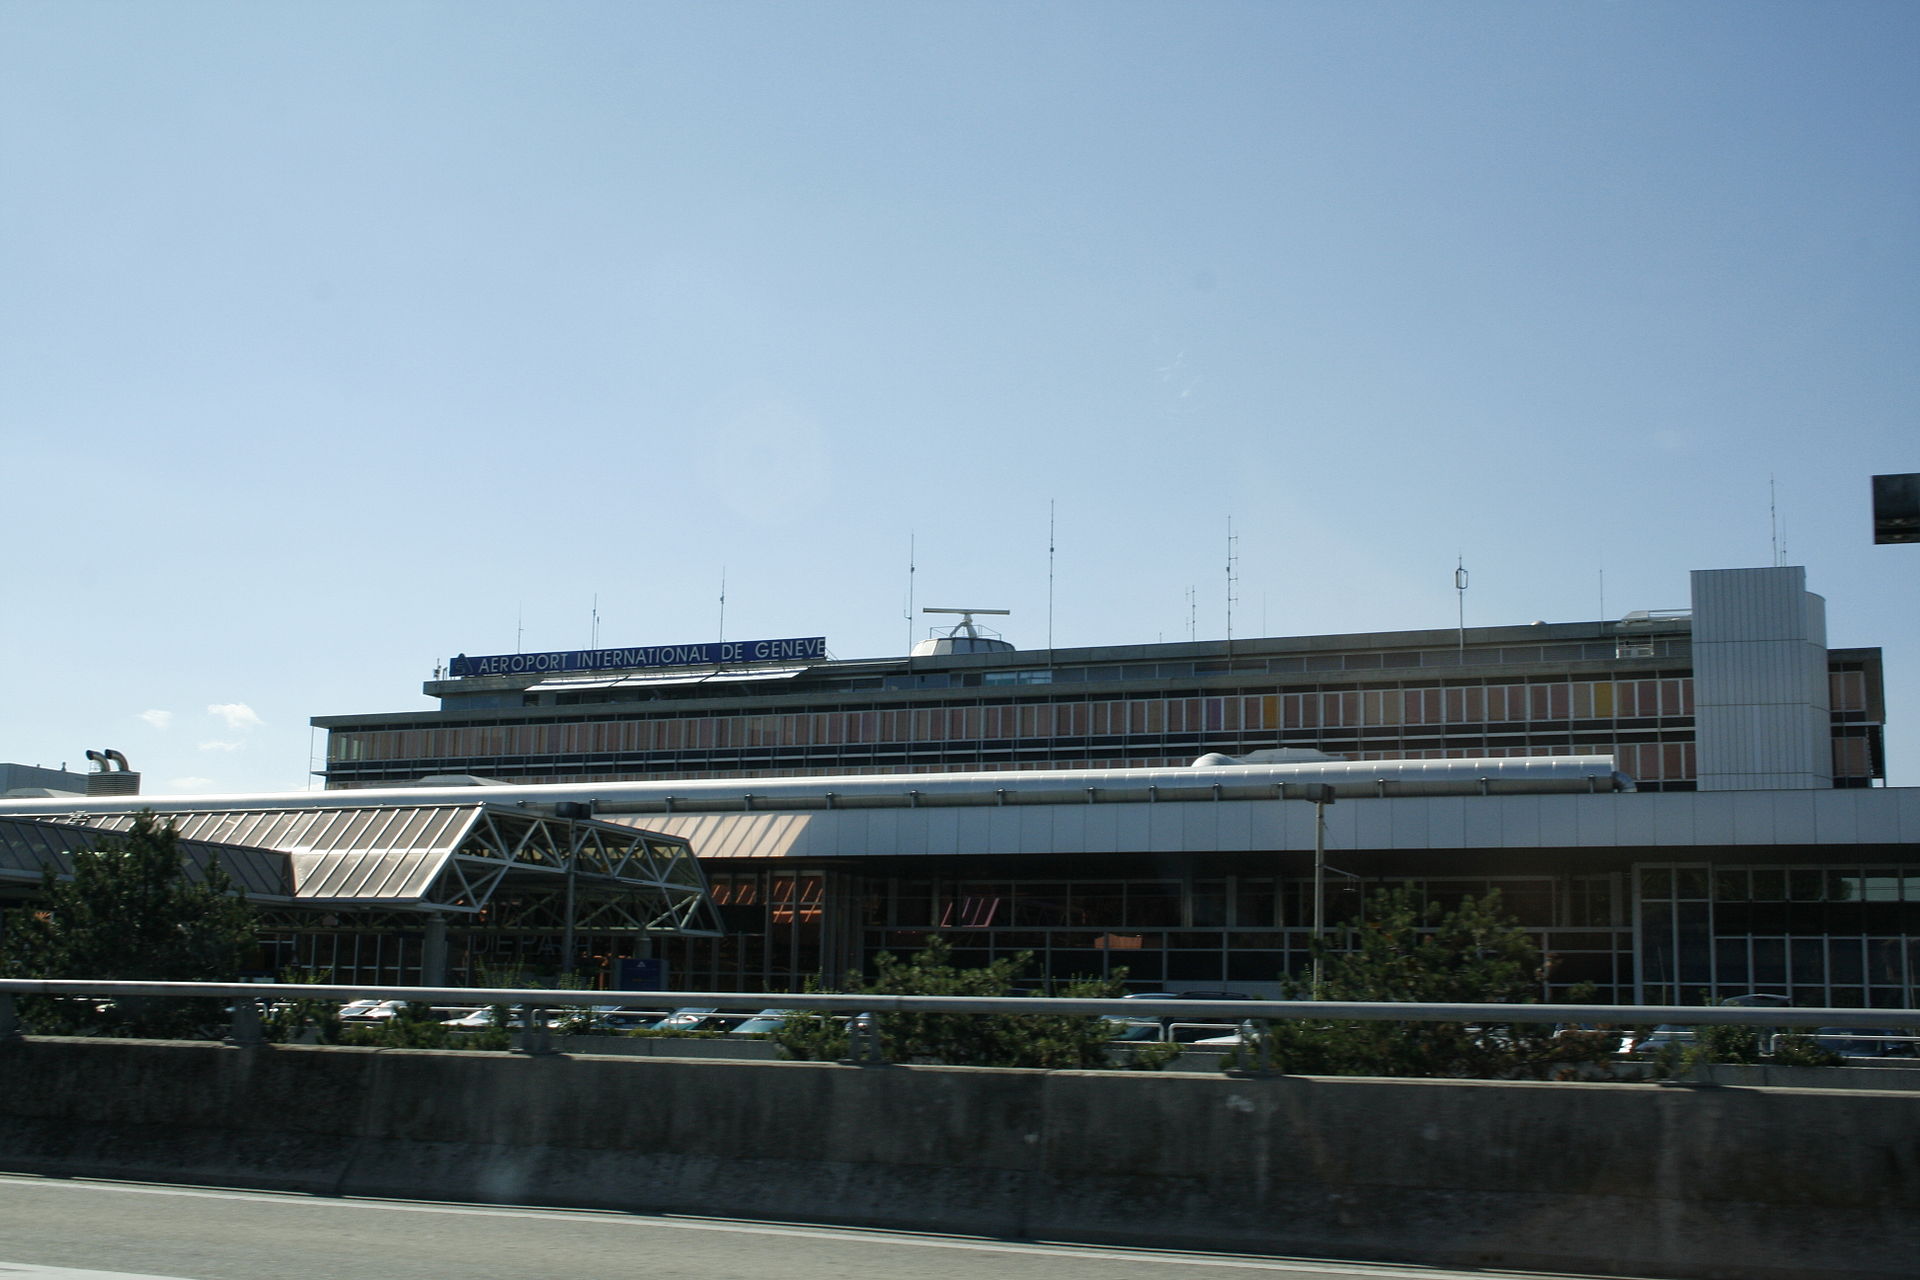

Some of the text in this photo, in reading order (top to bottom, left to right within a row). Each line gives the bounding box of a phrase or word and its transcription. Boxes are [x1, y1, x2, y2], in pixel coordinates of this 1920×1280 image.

[478, 638, 825, 673] AEROPORT INTERNATIONAL DE GENEVE
